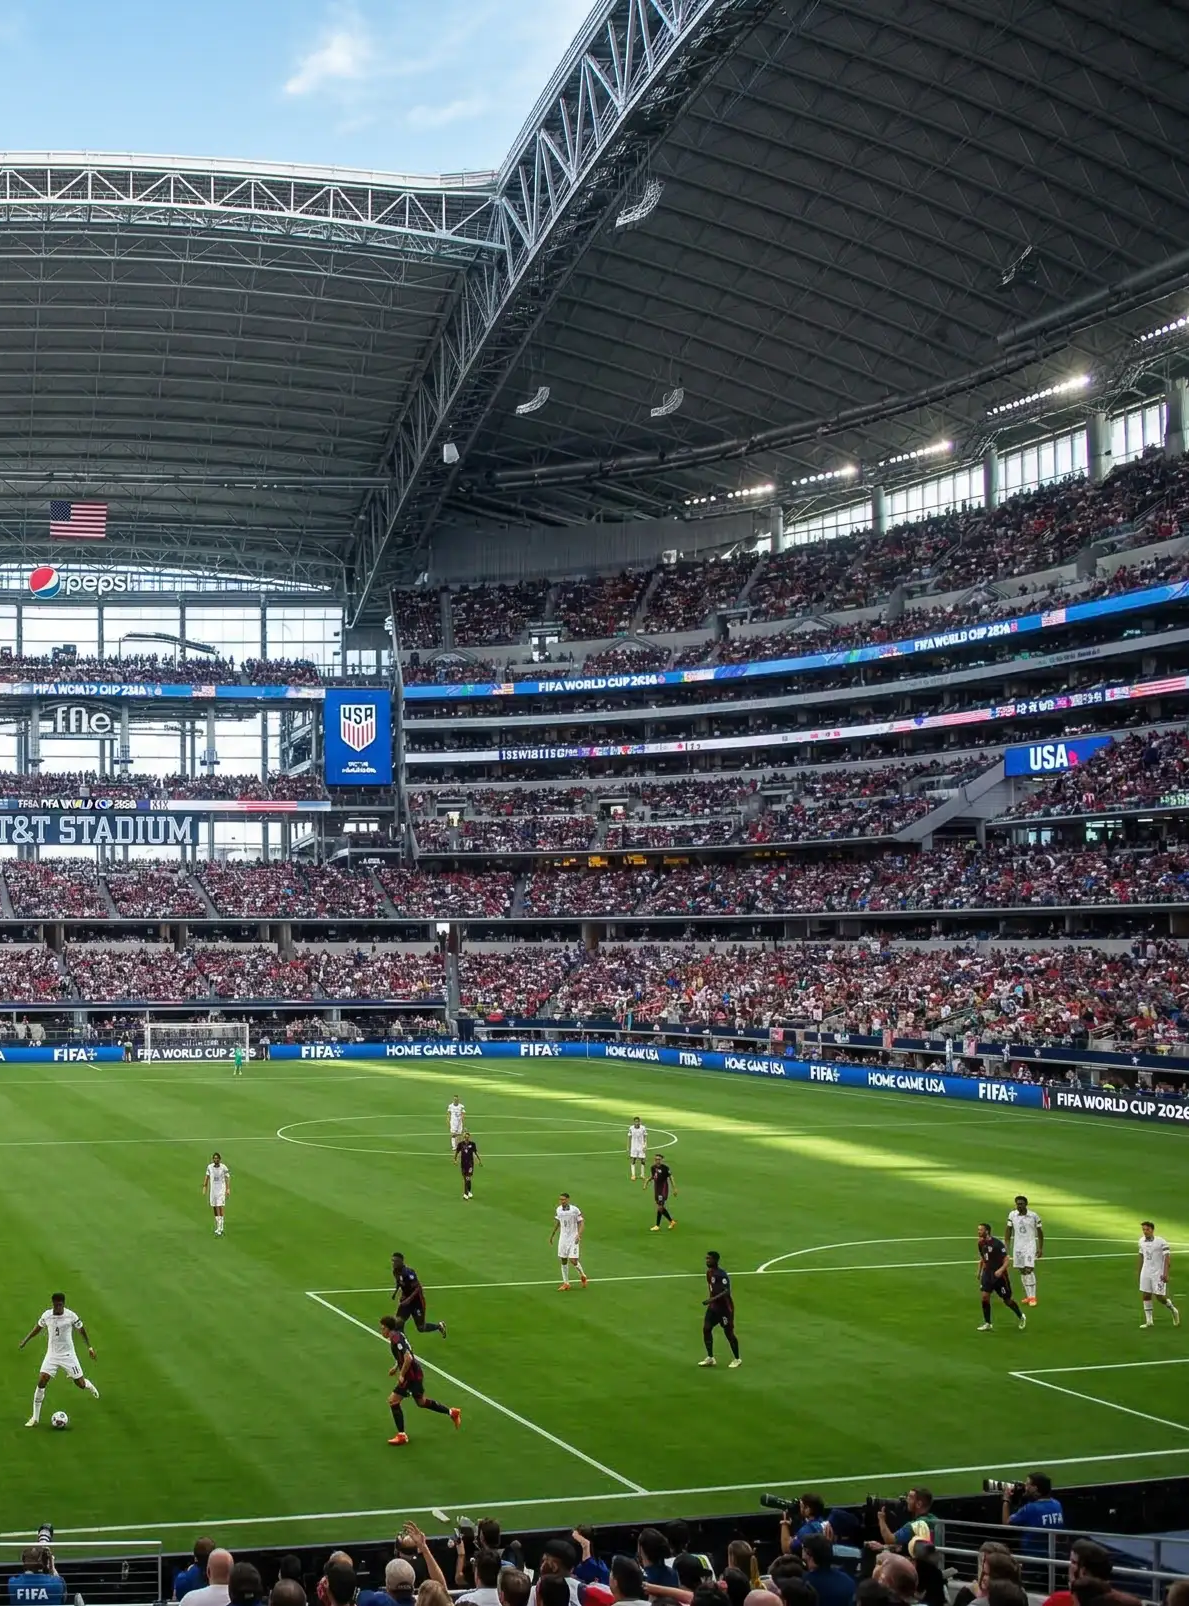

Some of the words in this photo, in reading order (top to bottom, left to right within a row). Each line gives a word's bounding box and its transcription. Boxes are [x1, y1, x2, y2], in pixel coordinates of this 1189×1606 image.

[538, 681, 564, 693] FIFA
[565, 679, 606, 690] WORLD
[607, 677, 630, 688] CUP
[342, 707, 373, 725] USA
[1029, 744, 1068, 770] USA
[59, 815, 193, 844] STADIUM
[162, 1048, 203, 1059] WORLD
[204, 1048, 227, 1059] CUP
[386, 1044, 422, 1056] HOME
[423, 1044, 459, 1056] GAME
[459, 1044, 482, 1056] USA
[868, 1072, 896, 1088] HOME
[897, 1075, 925, 1092] GAME
[925, 1078, 946, 1093] USA
[1057, 1093, 1082, 1108] FIFA
[1082, 1095, 1129, 1112] WORLD
[1130, 1100, 1156, 1116] CUP
[1157, 1104, 1189, 1120] 2026
[1041, 1512, 1064, 1526] FIFA
[16, 1588, 49, 1600] FIFA
